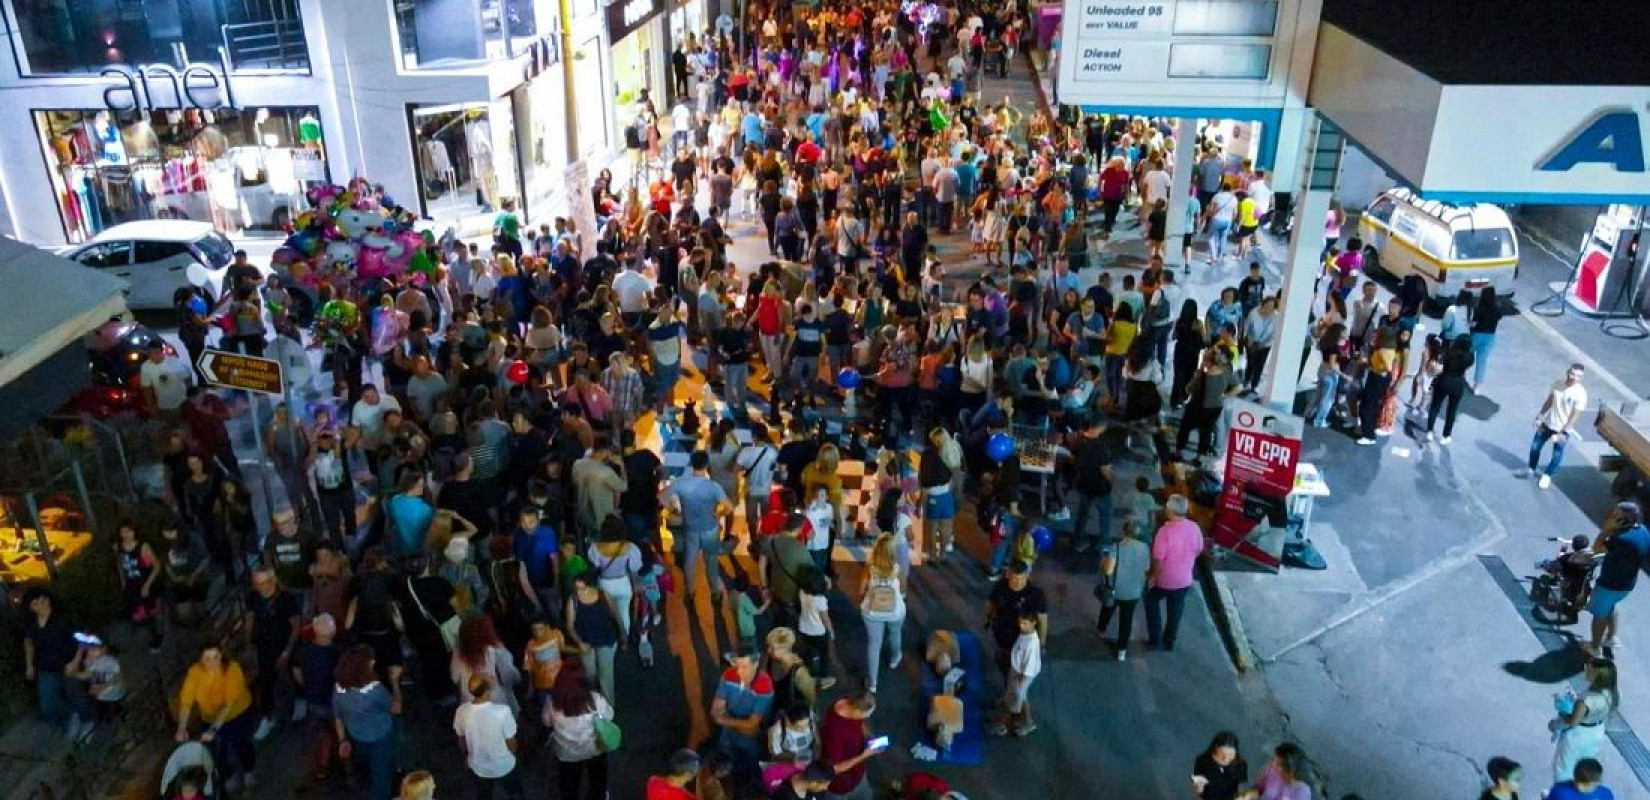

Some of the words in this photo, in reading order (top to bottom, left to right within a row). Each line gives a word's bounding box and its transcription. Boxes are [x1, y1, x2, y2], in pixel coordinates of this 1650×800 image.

[1087, 5, 1145, 16] Unleaded
[1147, 6, 1163, 16] 95
[1107, 21, 1138, 29] VALUE
[1083, 48, 1122, 59] Diesel
[1083, 63, 1122, 72] ACTION
[101, 46, 235, 109] anel
[1534, 102, 1650, 172] A
[1235, 431, 1255, 454] VR
[1259, 440, 1291, 468] CPR
